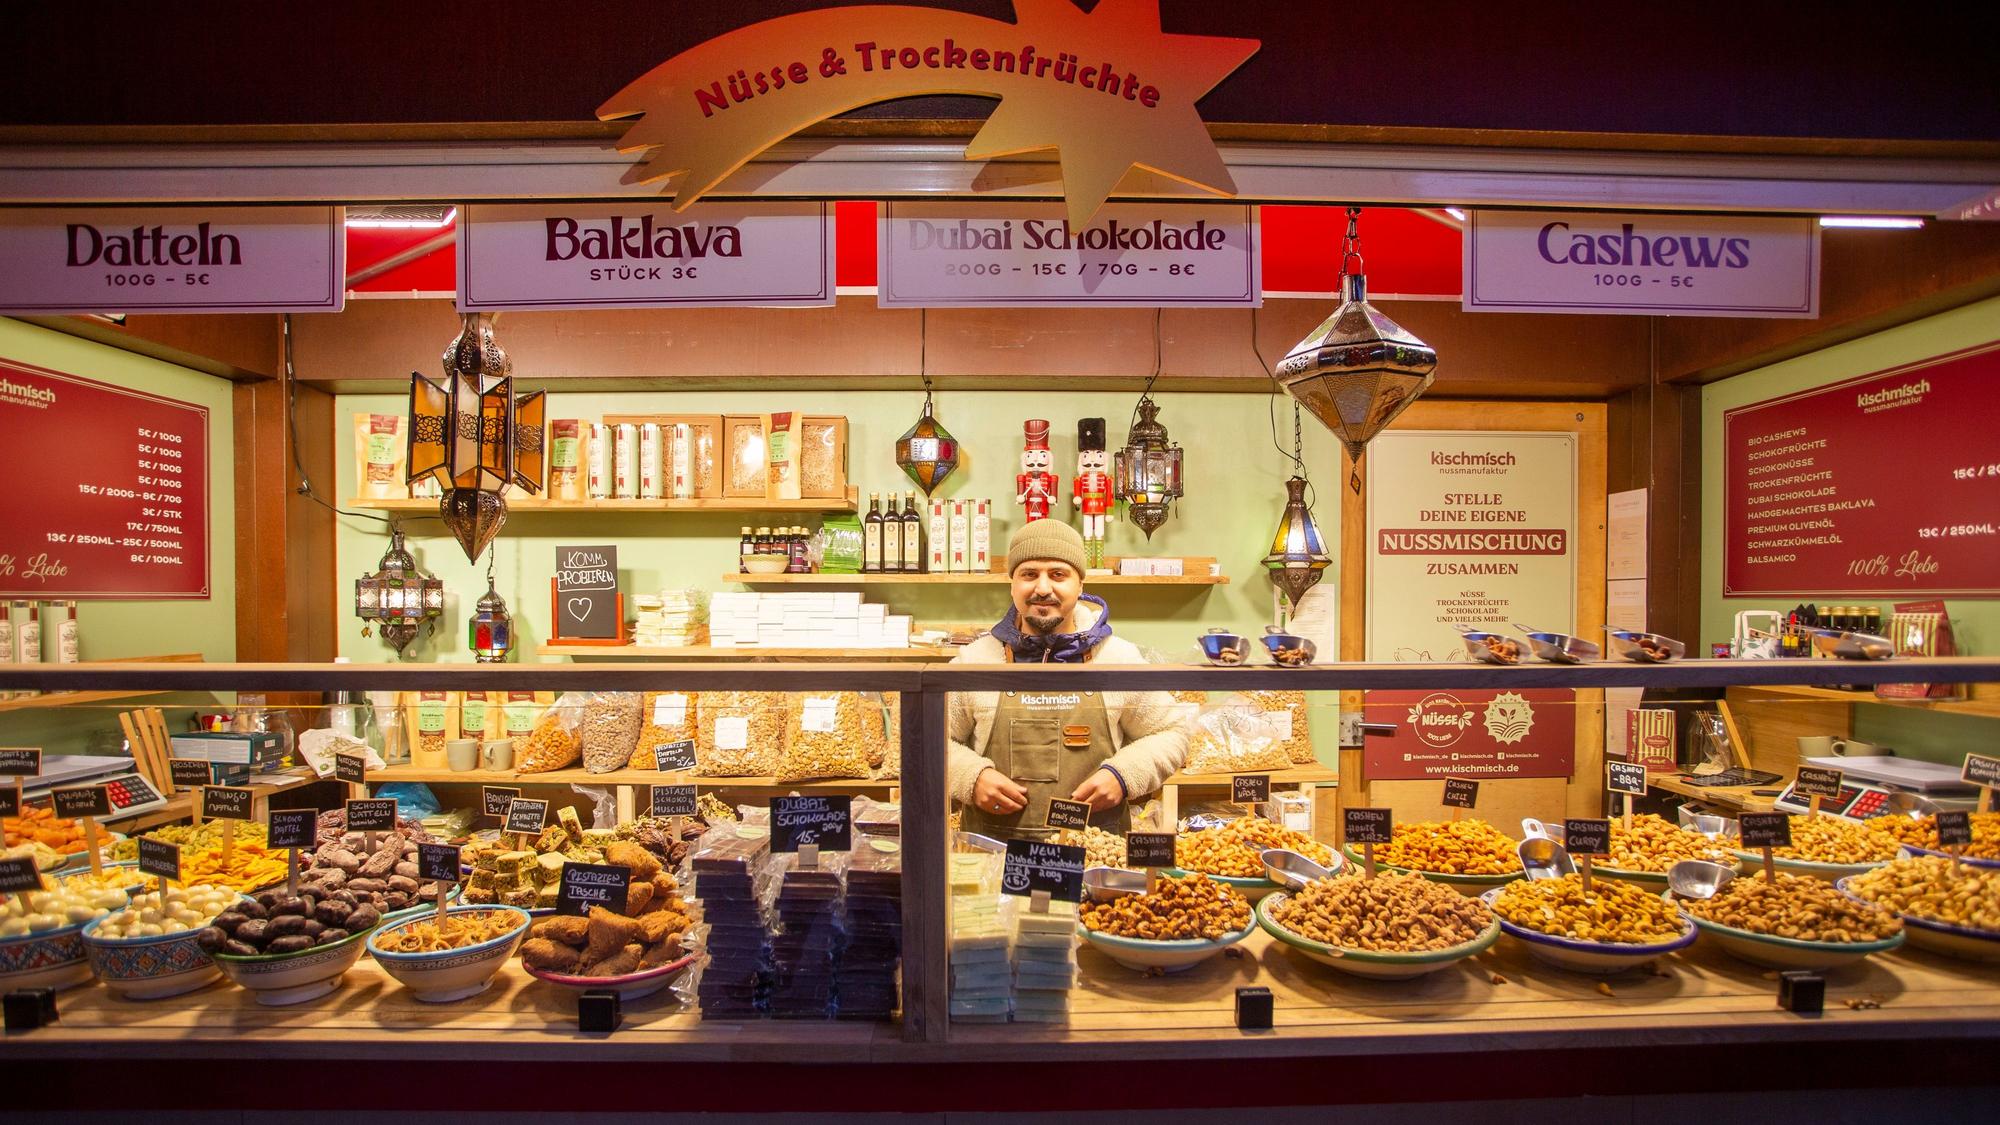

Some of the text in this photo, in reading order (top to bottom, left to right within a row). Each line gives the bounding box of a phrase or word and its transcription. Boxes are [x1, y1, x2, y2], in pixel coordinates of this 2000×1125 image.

[694, 38, 1161, 118] Nüsse & Trockenfrüchte
[545, 214, 743, 261] Baklava
[908, 219, 1226, 251] Dubai Schokolade
[66, 221, 242, 267] Datteln
[1537, 221, 1750, 269] Cashews
[590, 265, 698, 281] STÜCK 3€
[945, 263, 1195, 276] 200G 15€ / 70G 8€
[105, 273, 210, 287] 100G 5€
[1594, 274, 1694, 288] 100G 5€
[1864, 396, 1922, 414] nussmanufaktur
[138, 428, 151, 437] 5€
[159, 432, 182, 443] 100G
[1748, 427, 1807, 446] BIO CASHEWS
[138, 444, 151, 453] 5€
[159, 448, 182, 458] 100G
[1748, 439, 1827, 461] SCHOKOFRÜCHTE
[138, 460, 151, 469] 5€
[159, 463, 182, 473] 100G
[1440, 467, 1508, 475] nussmanufaktur
[1748, 457, 1814, 475] SCHOKONÜSSE
[1953, 466, 1984, 479] 15€ /
[138, 476, 151, 485] 5€
[159, 479, 182, 489] 100G
[1748, 470, 1832, 490] TROCKENFRÜCHTE
[79, 484, 97, 494] 15€
[99, 487, 105, 495] /
[106, 488, 135, 498] 200G
[143, 492, 157, 501] 8€
[164, 494, 182, 504] 70G
[1444, 493, 1503, 505] STELLE
[1748, 486, 1837, 505] DUBAI SCHOKOLADE
[142, 507, 155, 517] 3€
[163, 509, 182, 519] STK
[1420, 510, 1526, 522] DEINE EIGENE
[1748, 499, 1875, 519] HANDGEMACHTES BAKLAVA
[127, 522, 143, 531] 17€
[151, 524, 183, 534] 750ML
[1748, 518, 1835, 534] PREMIUM OLIVENÖL
[1918, 523, 1995, 538] 13€ / 250ML
[46, 532, 67, 542] 13€
[68, 534, 75, 543] /
[77, 534, 114, 545] 250ML
[123, 538, 142, 547] 25€
[150, 539, 183, 549] 500ML
[1382, 533, 1563, 551] NUSSMISCHUNG
[1748, 534, 1843, 549] SCHWARZKÜMMELÖL
[131, 554, 144, 563] 8€
[152, 555, 183, 564] 100ML
[568, 551, 604, 568] KOMM
[1748, 554, 1796, 563] BALSAMICO
[1847, 550, 1939, 581] 100% Liebe
[21, 553, 68, 584] Liebe
[1426, 563, 1519, 575] ZUSAMMEN
[557, 569, 615, 587] PROBIEREN
[1460, 590, 1486, 598] NÜSSE
[1436, 598, 1510, 606] TROCKENFRÜCHTE
[1446, 607, 1499, 615] SCHOKOLADE
[1483, 615, 1509, 623] MEHR!
[1422, 712, 1458, 726] NÜSSE
[1425, 763, 1520, 774] www.kischmisch.de
[1610, 763, 1643, 774] CASHEW
[1800, 771, 1836, 782] CASHEW
[1447, 780, 1474, 790] CASHEW
[1446, 792, 1468, 801] CHILI
[778, 798, 827, 811] DUBAI
[349, 810, 391, 819] DATTELN
[777, 811, 847, 827] SCHOKOLADE
[1348, 811, 1385, 821] CASHEW
[1568, 822, 1607, 833] CASHEW
[1130, 835, 1168, 845] CASHEW
[1568, 835, 1601, 848] CURRY
[1030, 843, 1061, 858] NEU!
[1007, 853, 1037, 865] Dubai
[568, 869, 620, 884] PISTAZIEN
[569, 885, 607, 899] TASCHE
